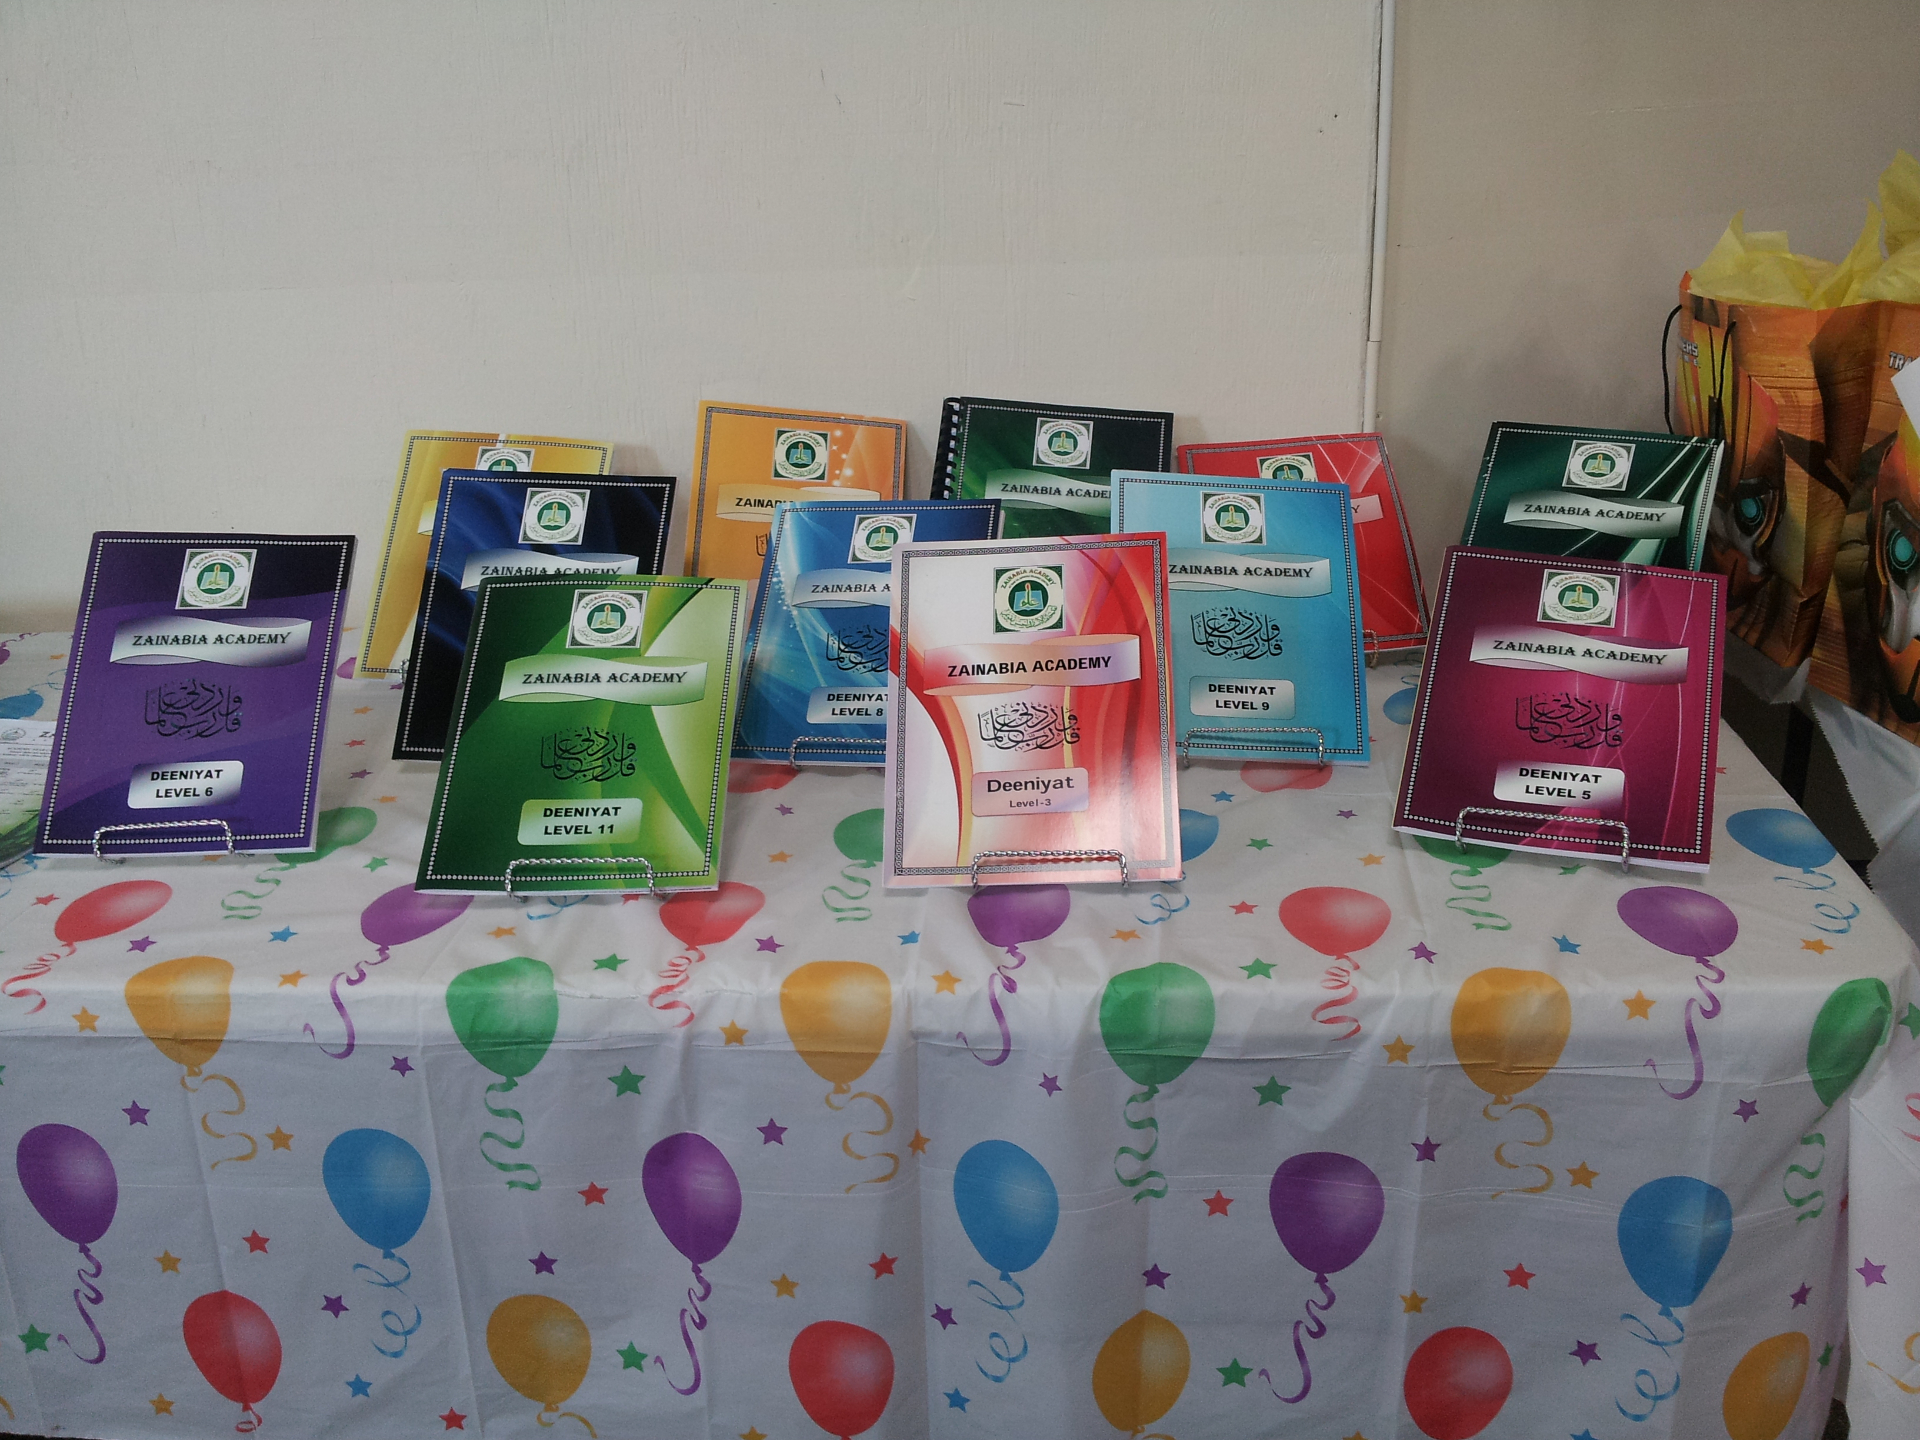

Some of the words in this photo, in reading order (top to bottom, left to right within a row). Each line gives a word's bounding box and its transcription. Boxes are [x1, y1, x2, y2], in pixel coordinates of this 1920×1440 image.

[1001, 483, 1062, 496] ZAINABIA
[1065, 488, 1111, 499] ACADE
[735, 497, 794, 508] ZAINA
[1523, 504, 1591, 517] ZAINABIA
[1595, 508, 1666, 522] ACADEMY
[480, 566, 548, 576] ZAINABIA
[1168, 564, 1239, 576] ZAINABIA
[1243, 566, 1314, 578] ACADEMY
[1001, 569, 1028, 589] ZAINABIA
[1029, 569, 1056, 585] ACADEMY
[811, 583, 877, 594] ZAINABIA
[132, 634, 208, 646] ZAINABIA
[212, 631, 292, 645] ACADEMY
[1492, 640, 1576, 656] ZAINABIA
[1581, 648, 1668, 665] ACADEMY
[947, 661, 1028, 678] ZAINABIA
[1031, 655, 1112, 673] ACADEMY
[522, 673, 601, 684] ZAINABIA
[606, 671, 688, 683] ACADEMY
[1208, 683, 1277, 696] DEENIYAT
[1215, 699, 1258, 711] LEVEL
[1261, 701, 1270, 711] 9
[831, 707, 872, 717] LEVEL
[875, 707, 884, 717] 8
[150, 769, 224, 781] DEENIYAT
[1518, 767, 1603, 784] DEENIYAT
[986, 776, 1075, 795] Deeniyat
[1524, 784, 1577, 799] LEVEL
[1581, 790, 1592, 800] 5
[155, 787, 201, 799] LEVEL
[204, 786, 214, 797] 6
[543, 806, 622, 818] DEENIYAT
[543, 824, 593, 836] LEVEL
[597, 823, 615, 835] 11
